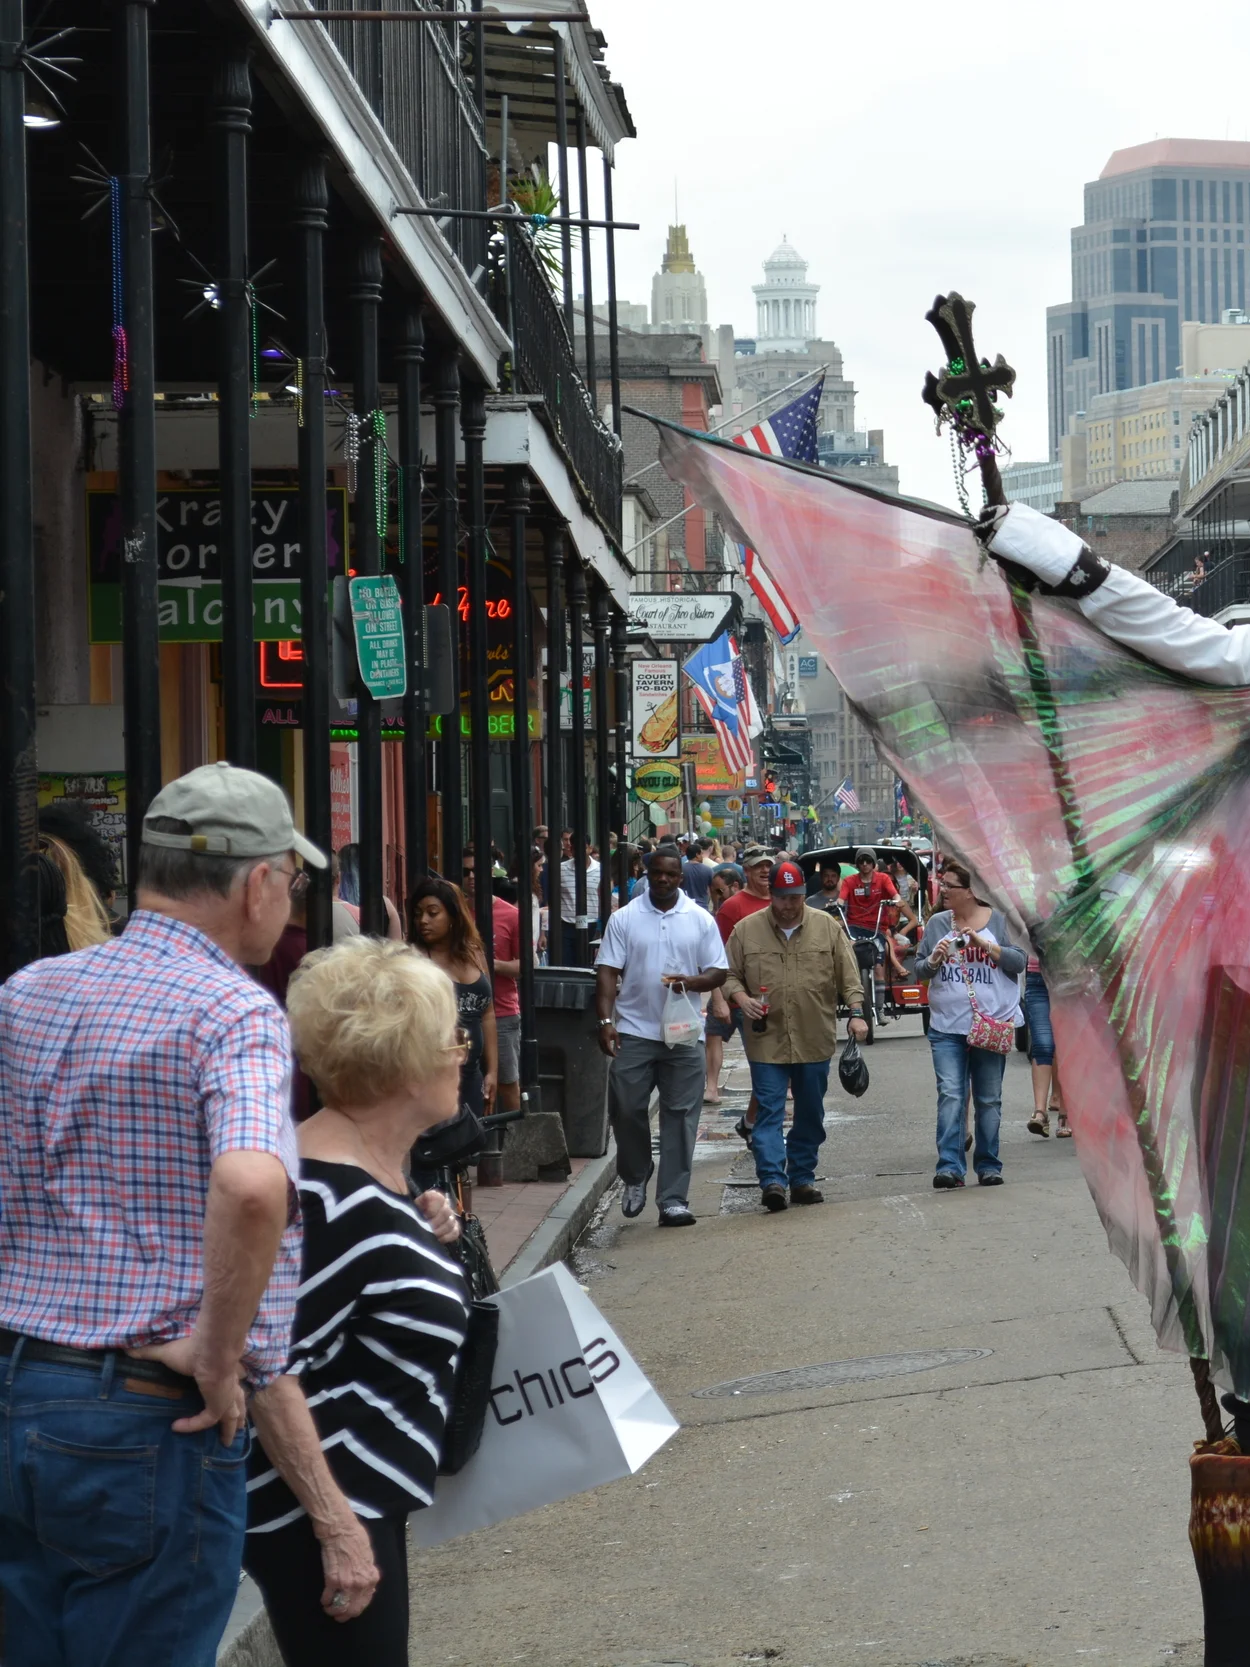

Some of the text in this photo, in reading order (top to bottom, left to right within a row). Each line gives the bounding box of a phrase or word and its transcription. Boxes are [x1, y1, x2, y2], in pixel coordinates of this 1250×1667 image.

[155, 495, 288, 535] Kray
[157, 541, 301, 571] orer
[380, 598, 395, 609] GLASS
[636, 604, 658, 620] Court
[658, 605, 669, 621] of
[689, 603, 715, 621] Sisters
[365, 621, 398, 633] ON STREET
[369, 640, 381, 650] ALL
[376, 649, 389, 659] MAY
[371, 660, 379, 669] IN
[800, 658, 816, 668] AC
[261, 708, 299, 725] ALL
[662, 776, 682, 788] CLU
